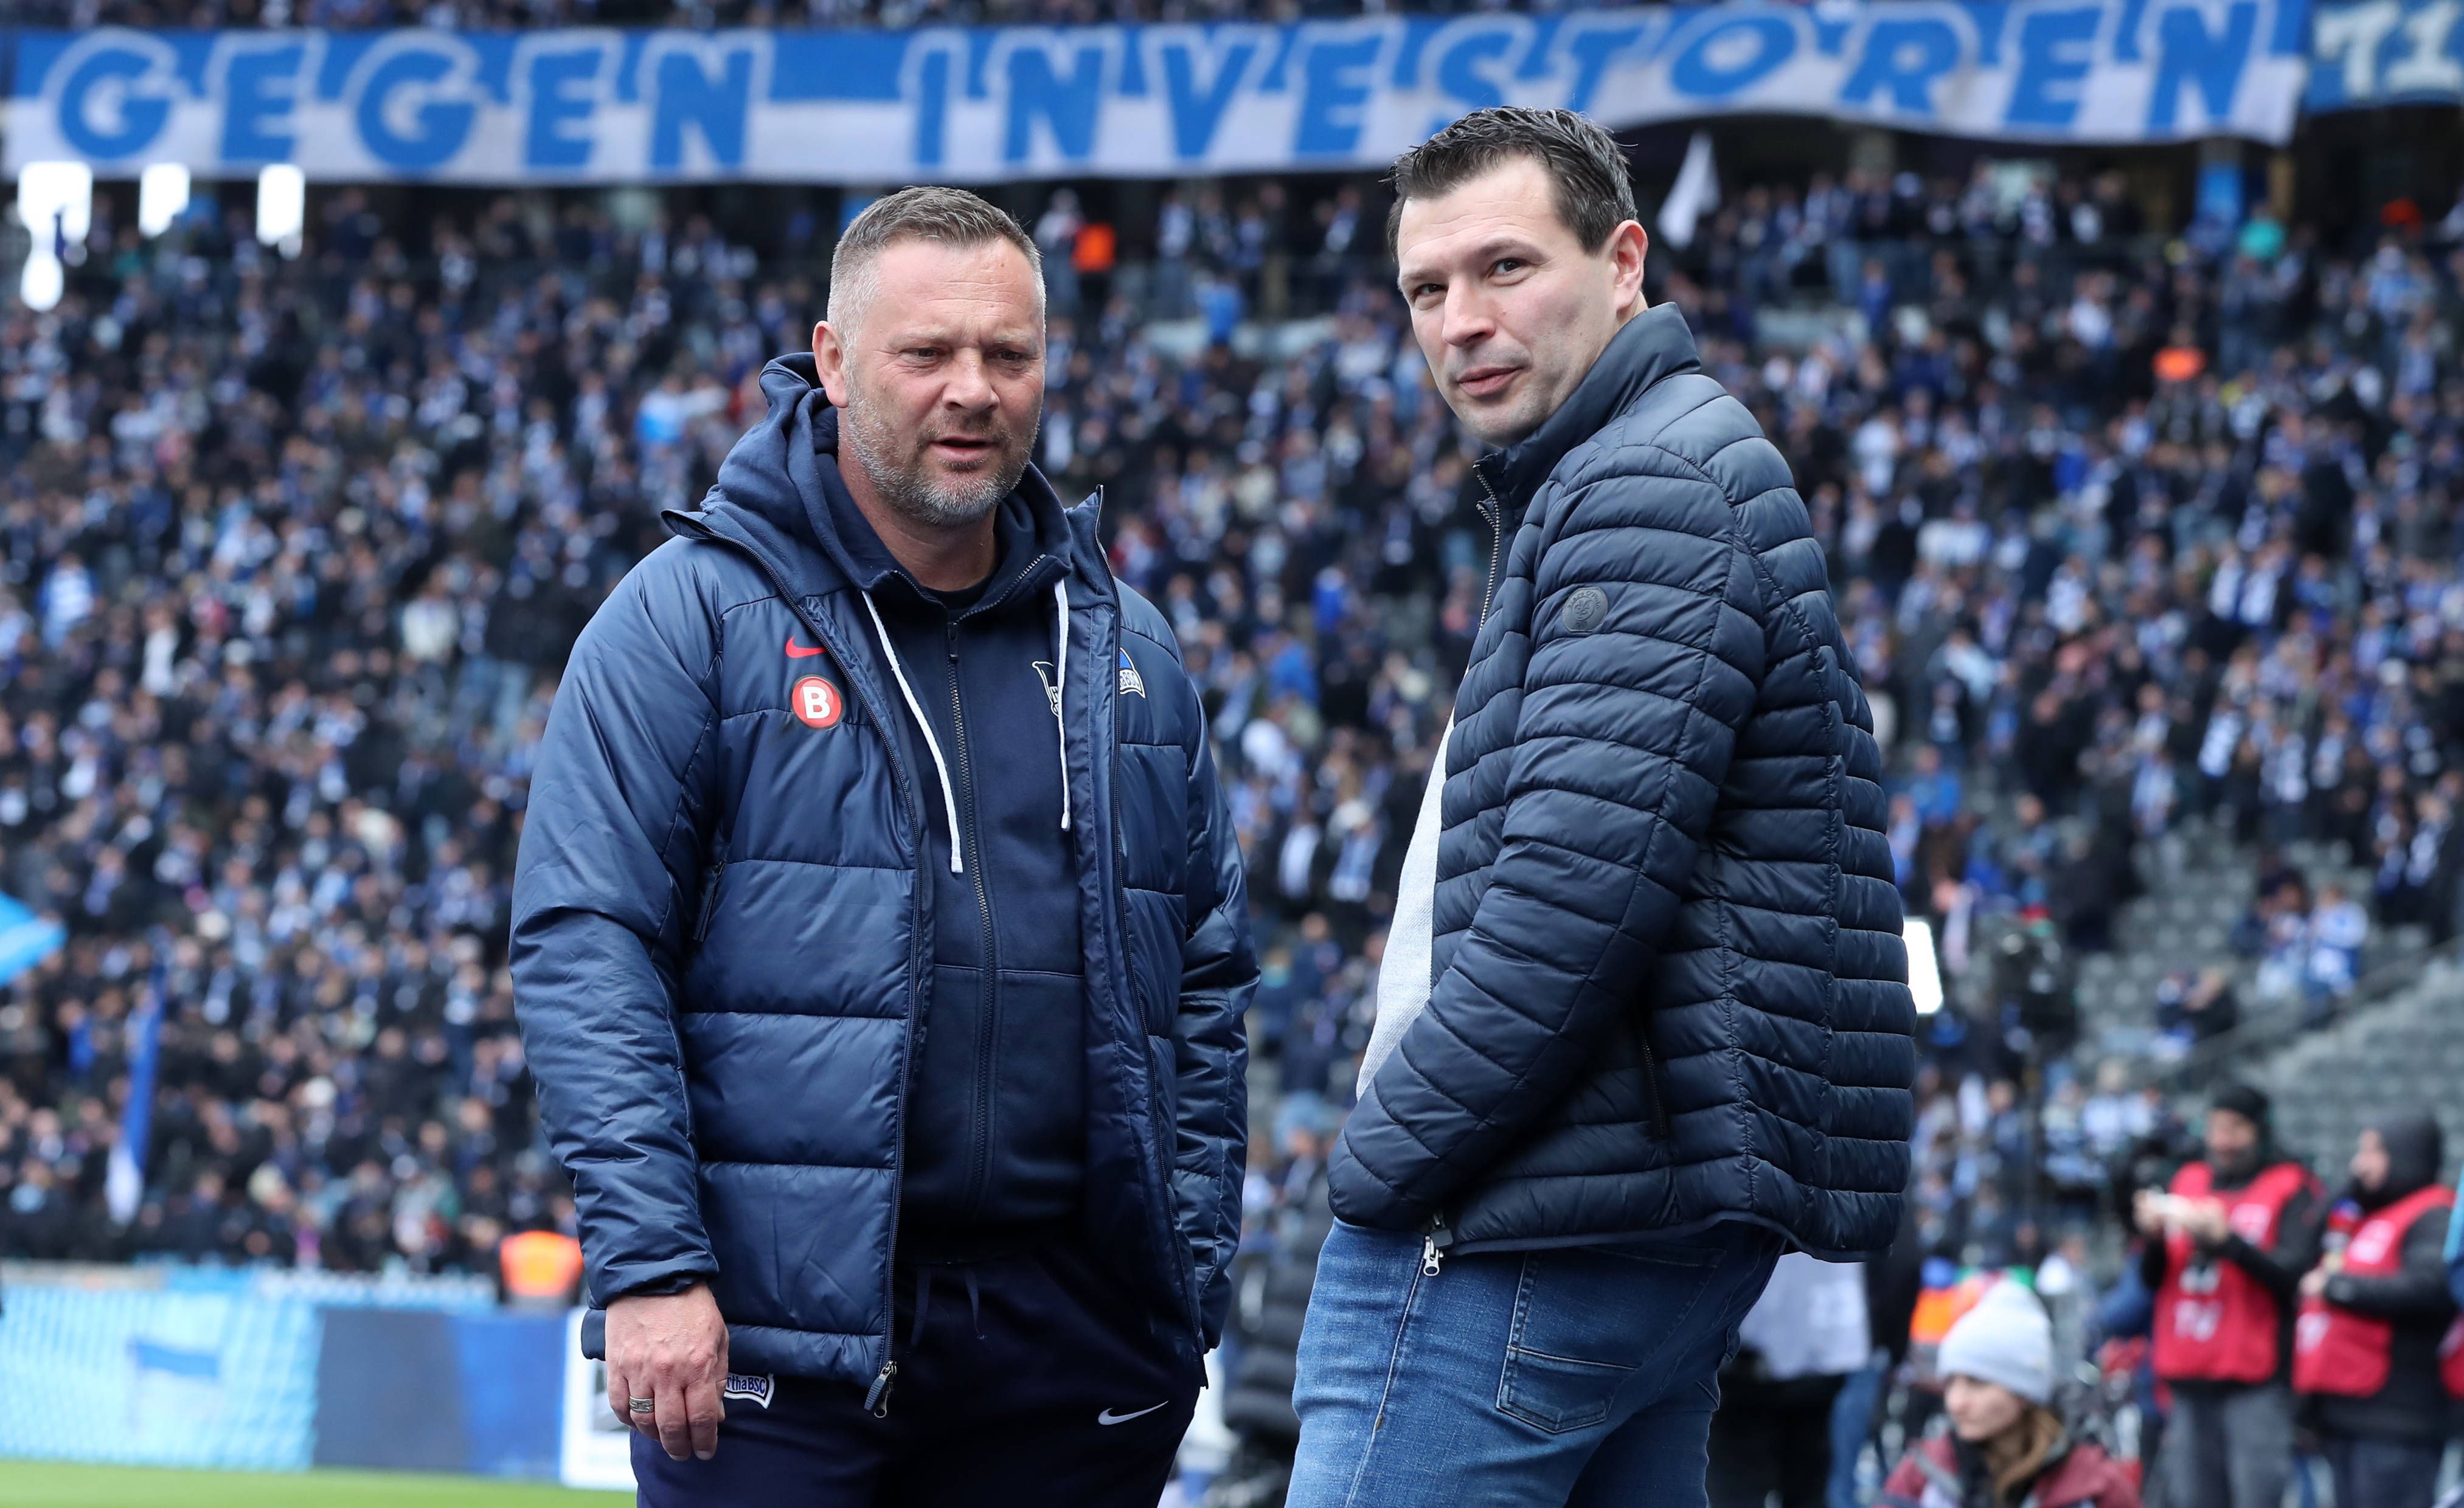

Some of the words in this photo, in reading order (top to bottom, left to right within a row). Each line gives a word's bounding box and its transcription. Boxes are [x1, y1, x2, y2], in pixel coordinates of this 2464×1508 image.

[2313, 1, 2460, 97] 71
[54, 41, 758, 170] GEGEN
[908, 7, 2259, 167] INVESTOREN
[802, 686, 831, 719] B
[727, 1374, 766, 1394] rthaBSC
